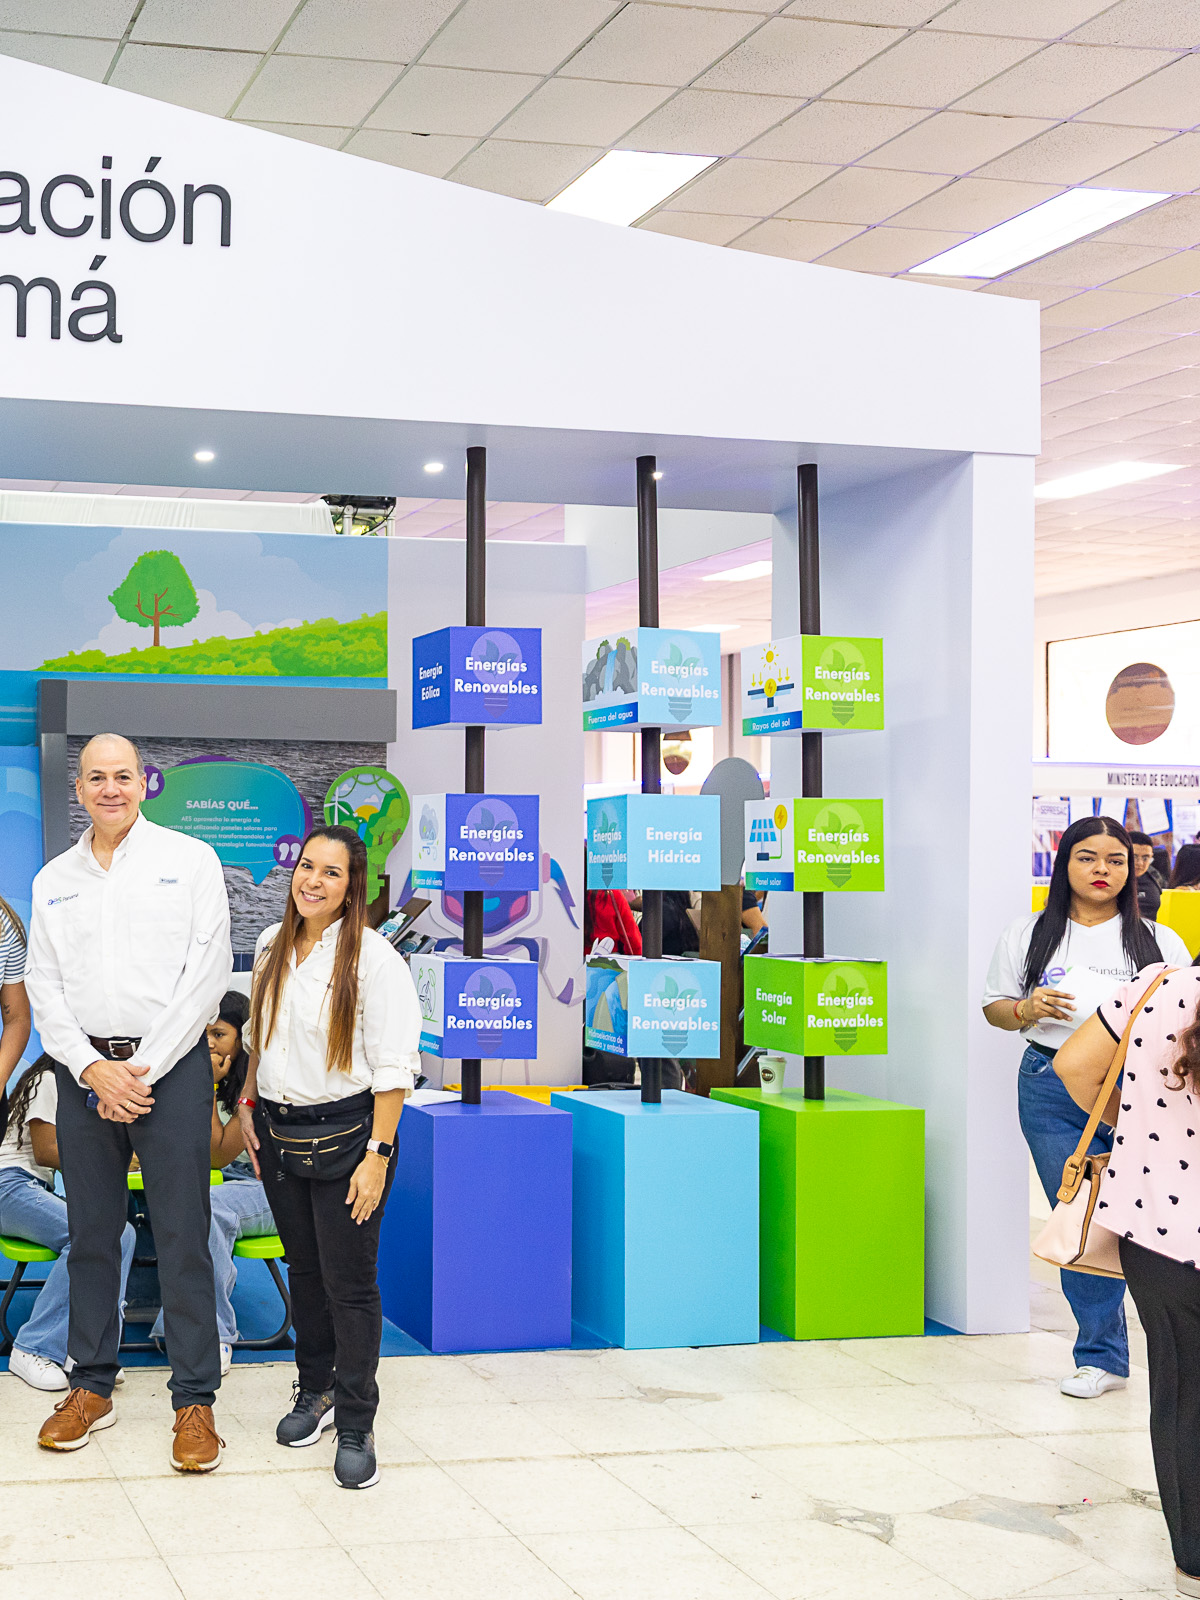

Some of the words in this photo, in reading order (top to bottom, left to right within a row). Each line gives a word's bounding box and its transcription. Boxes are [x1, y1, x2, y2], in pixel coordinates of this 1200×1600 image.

[419, 663, 443, 680] Energía
[465, 656, 528, 674] Energías
[651, 660, 709, 678] Energías
[814, 666, 870, 683] Energías
[421, 685, 441, 701] Eólica
[454, 678, 538, 695] Renovables
[641, 682, 719, 699] Renovables
[805, 687, 880, 702] Renovables
[587, 715, 607, 725] Fuerza
[607, 712, 617, 721] del
[618, 711, 633, 721] agua
[752, 722, 769, 731] Rayos
[771, 719, 781, 729] del
[781, 718, 791, 727] sol
[1107, 772, 1147, 787] MINISTERIO
[1149, 773, 1158, 787] DE
[186, 799, 225, 809] SABÍAS
[227, 799, 259, 810] QUÉ...
[460, 825, 524, 842] Energías
[593, 828, 622, 844] Energías
[646, 827, 703, 844] Energía
[808, 828, 869, 845] Energías
[449, 847, 535, 861] Renovables
[588, 850, 627, 864] Renovables
[648, 849, 701, 863] Hídrica
[797, 850, 880, 864] Renovables
[755, 877, 768, 886] Panel
[769, 878, 781, 886] solar
[458, 993, 522, 1010] Energías
[644, 993, 708, 1011] Energías
[756, 988, 793, 1007] Energía
[817, 993, 874, 1009] Energías
[447, 1015, 533, 1030] Renovables
[632, 1016, 719, 1031] Renovables
[761, 1009, 787, 1026] Solar
[807, 1014, 884, 1028] Renovables
[617, 1036, 623, 1045] de
